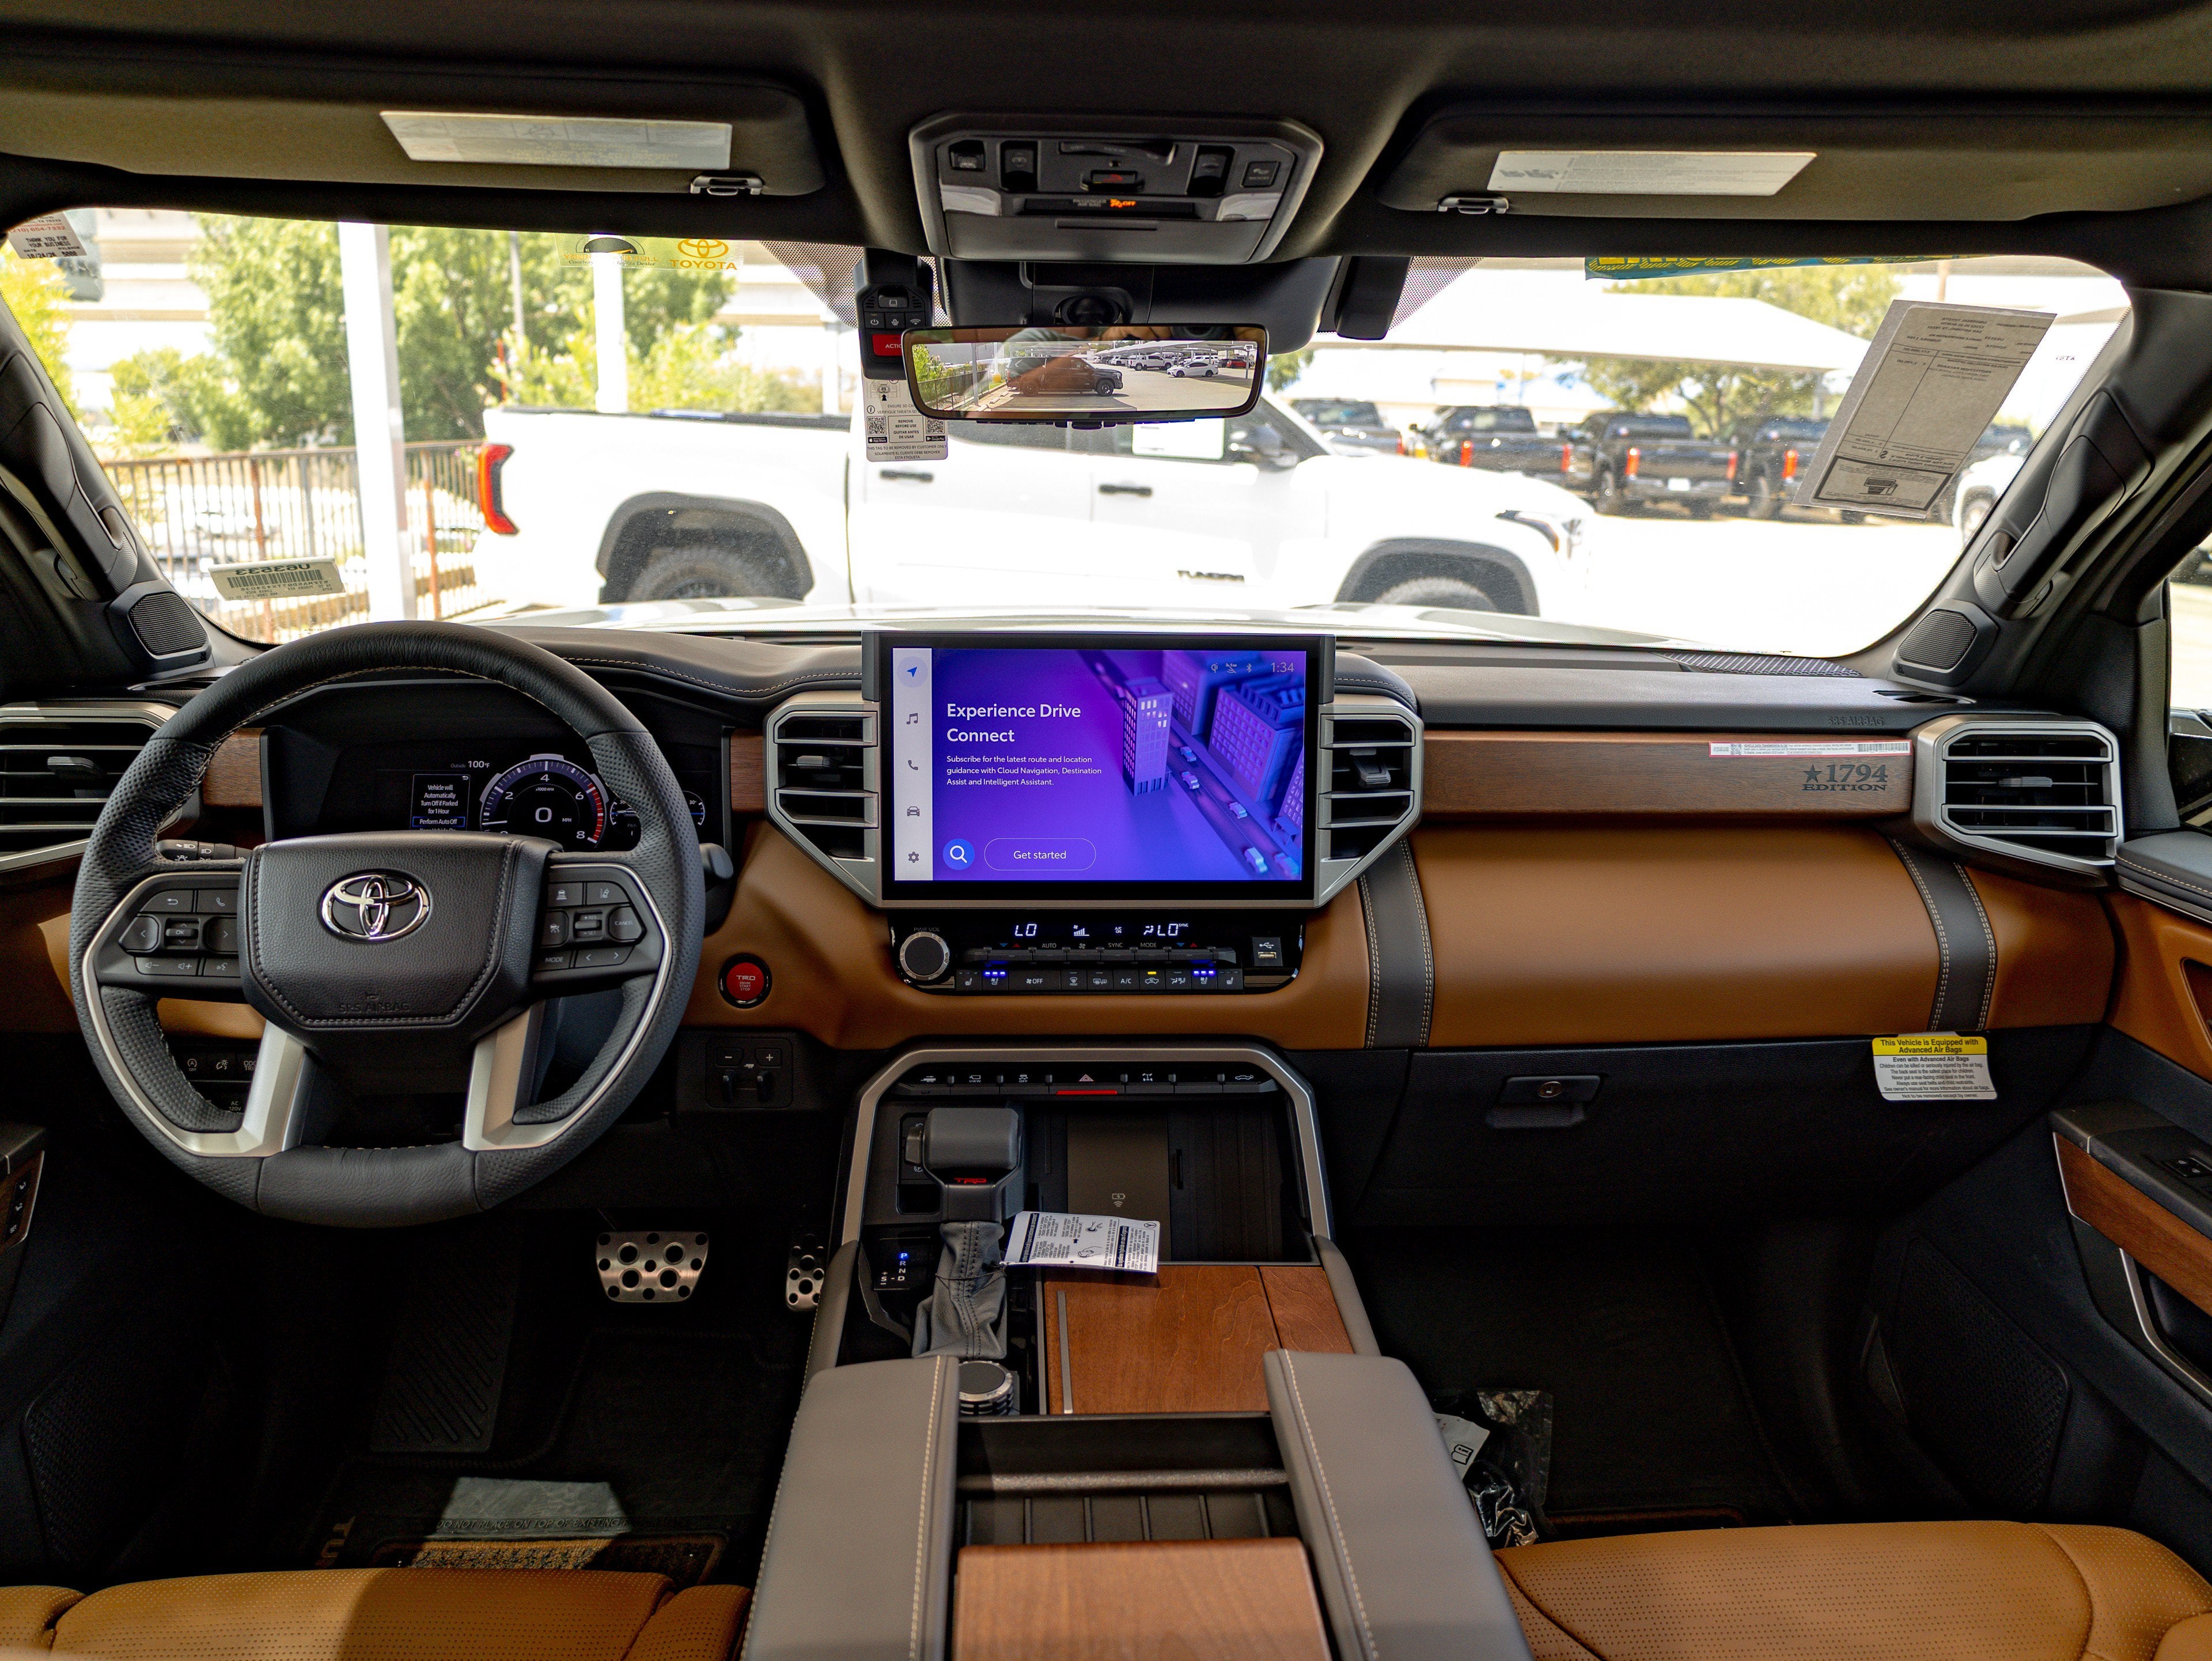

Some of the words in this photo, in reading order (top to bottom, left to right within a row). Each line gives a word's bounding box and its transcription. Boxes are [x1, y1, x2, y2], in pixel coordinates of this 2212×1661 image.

[669, 259, 737, 270] TOYOTA
[1270, 662, 1295, 673] 1:34
[947, 703, 1036, 720] Experience
[1040, 703, 1081, 717] Drive
[1827, 717, 1844, 725] SRS
[1846, 716, 1884, 726] AIRBAG
[947, 728, 1015, 742] Connect
[946, 767, 979, 775] guidance
[1020, 767, 1060, 775] Navigation,
[1826, 764, 1888, 784] 1794
[540, 774, 550, 782] 4
[983, 778, 1019, 787] Intelligent
[575, 792, 584, 800] 6
[535, 807, 552, 823] 0
[576, 831, 585, 839] 8
[1013, 850, 1031, 860] Get
[1033, 849, 1067, 860] started
[1014, 924, 1037, 937] LO
[1157, 924, 1179, 936] LO
[1931, 1039, 1963, 1047] Equipped
[437, 1520, 453, 1528] DO
[516, 1519, 531, 1527] ON
[533, 1519, 555, 1527] TOP
[555, 1519, 572, 1527] OF
[574, 1518, 620, 1527] EXISTING
